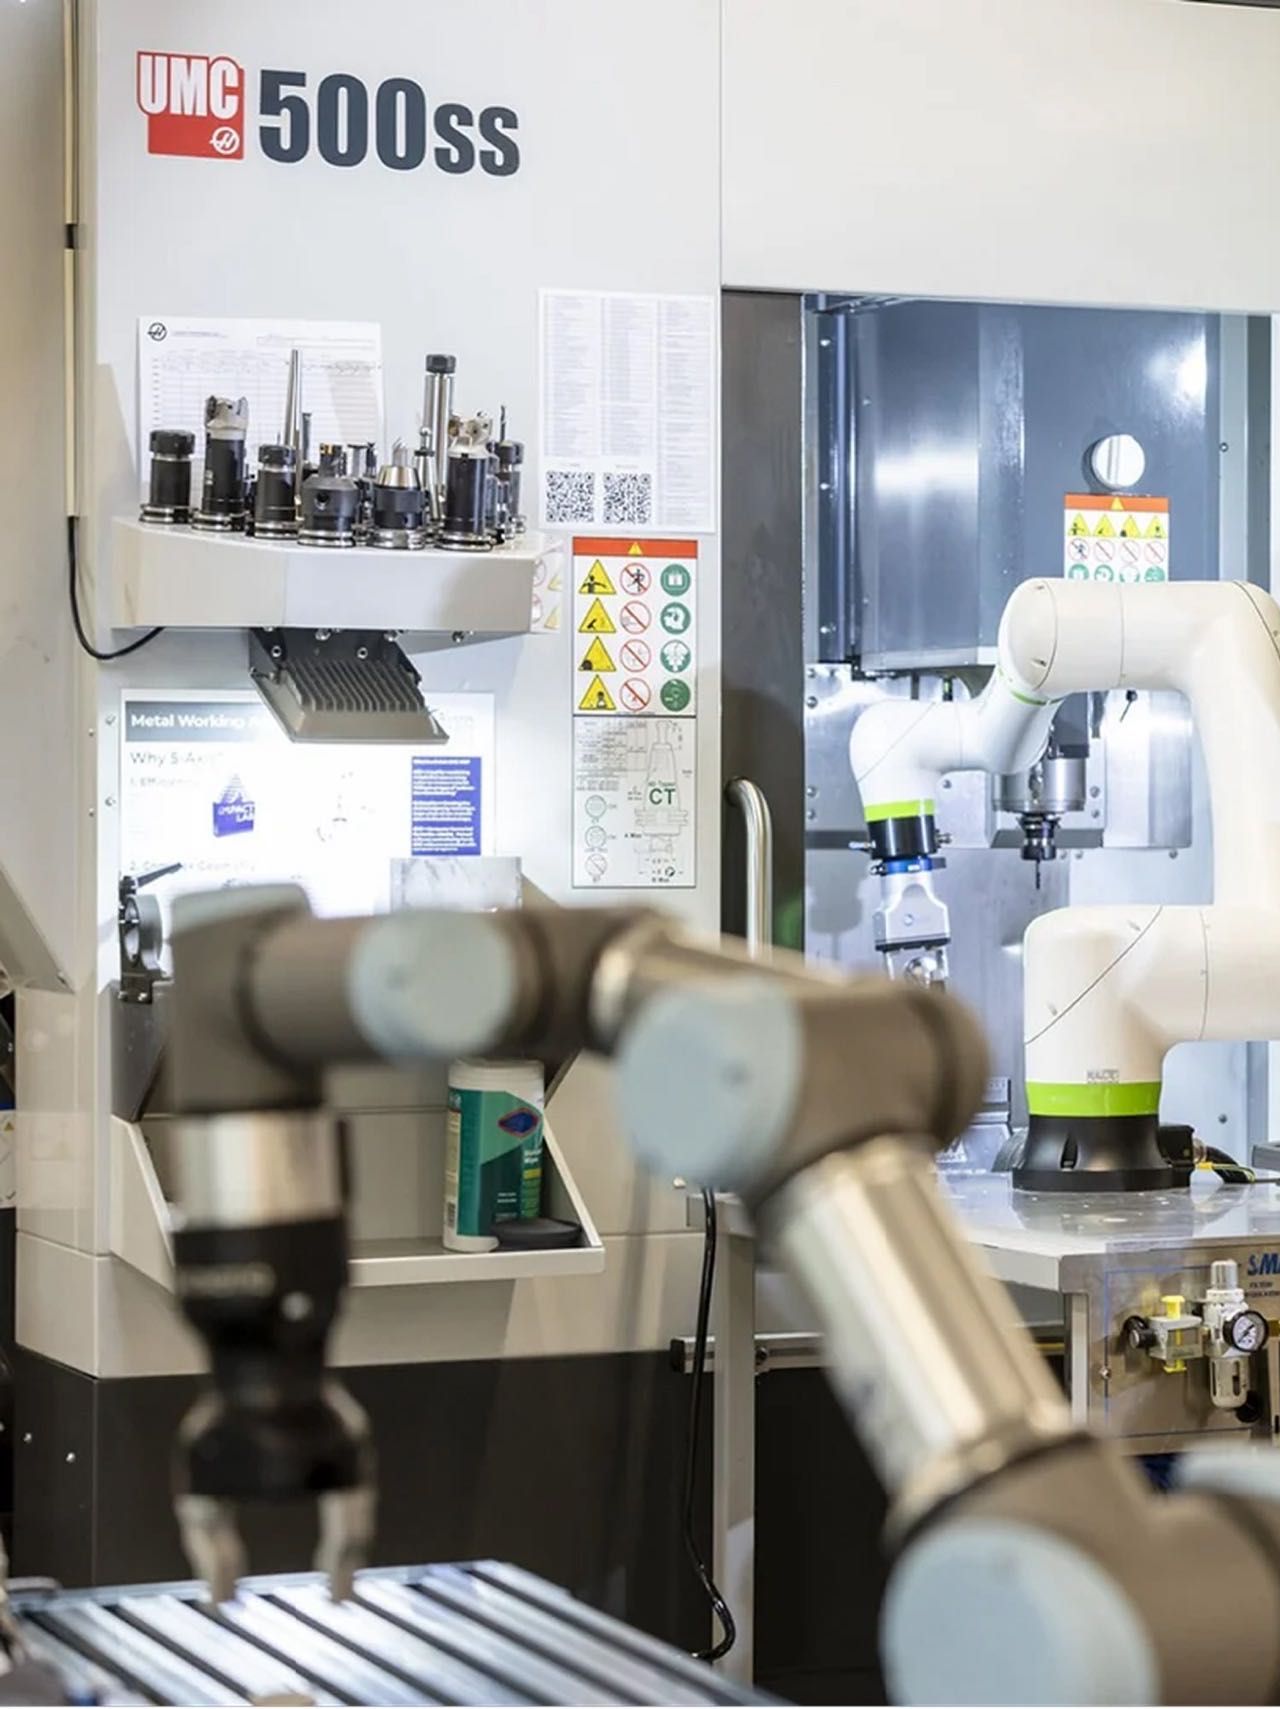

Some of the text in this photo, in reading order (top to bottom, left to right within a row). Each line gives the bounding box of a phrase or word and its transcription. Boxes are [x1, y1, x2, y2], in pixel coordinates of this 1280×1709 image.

[139, 53, 240, 120] UMC
[131, 714, 175, 728] Metal
[177, 714, 246, 729] Working
[129, 752, 166, 768] Why
[649, 788, 676, 805] CT
